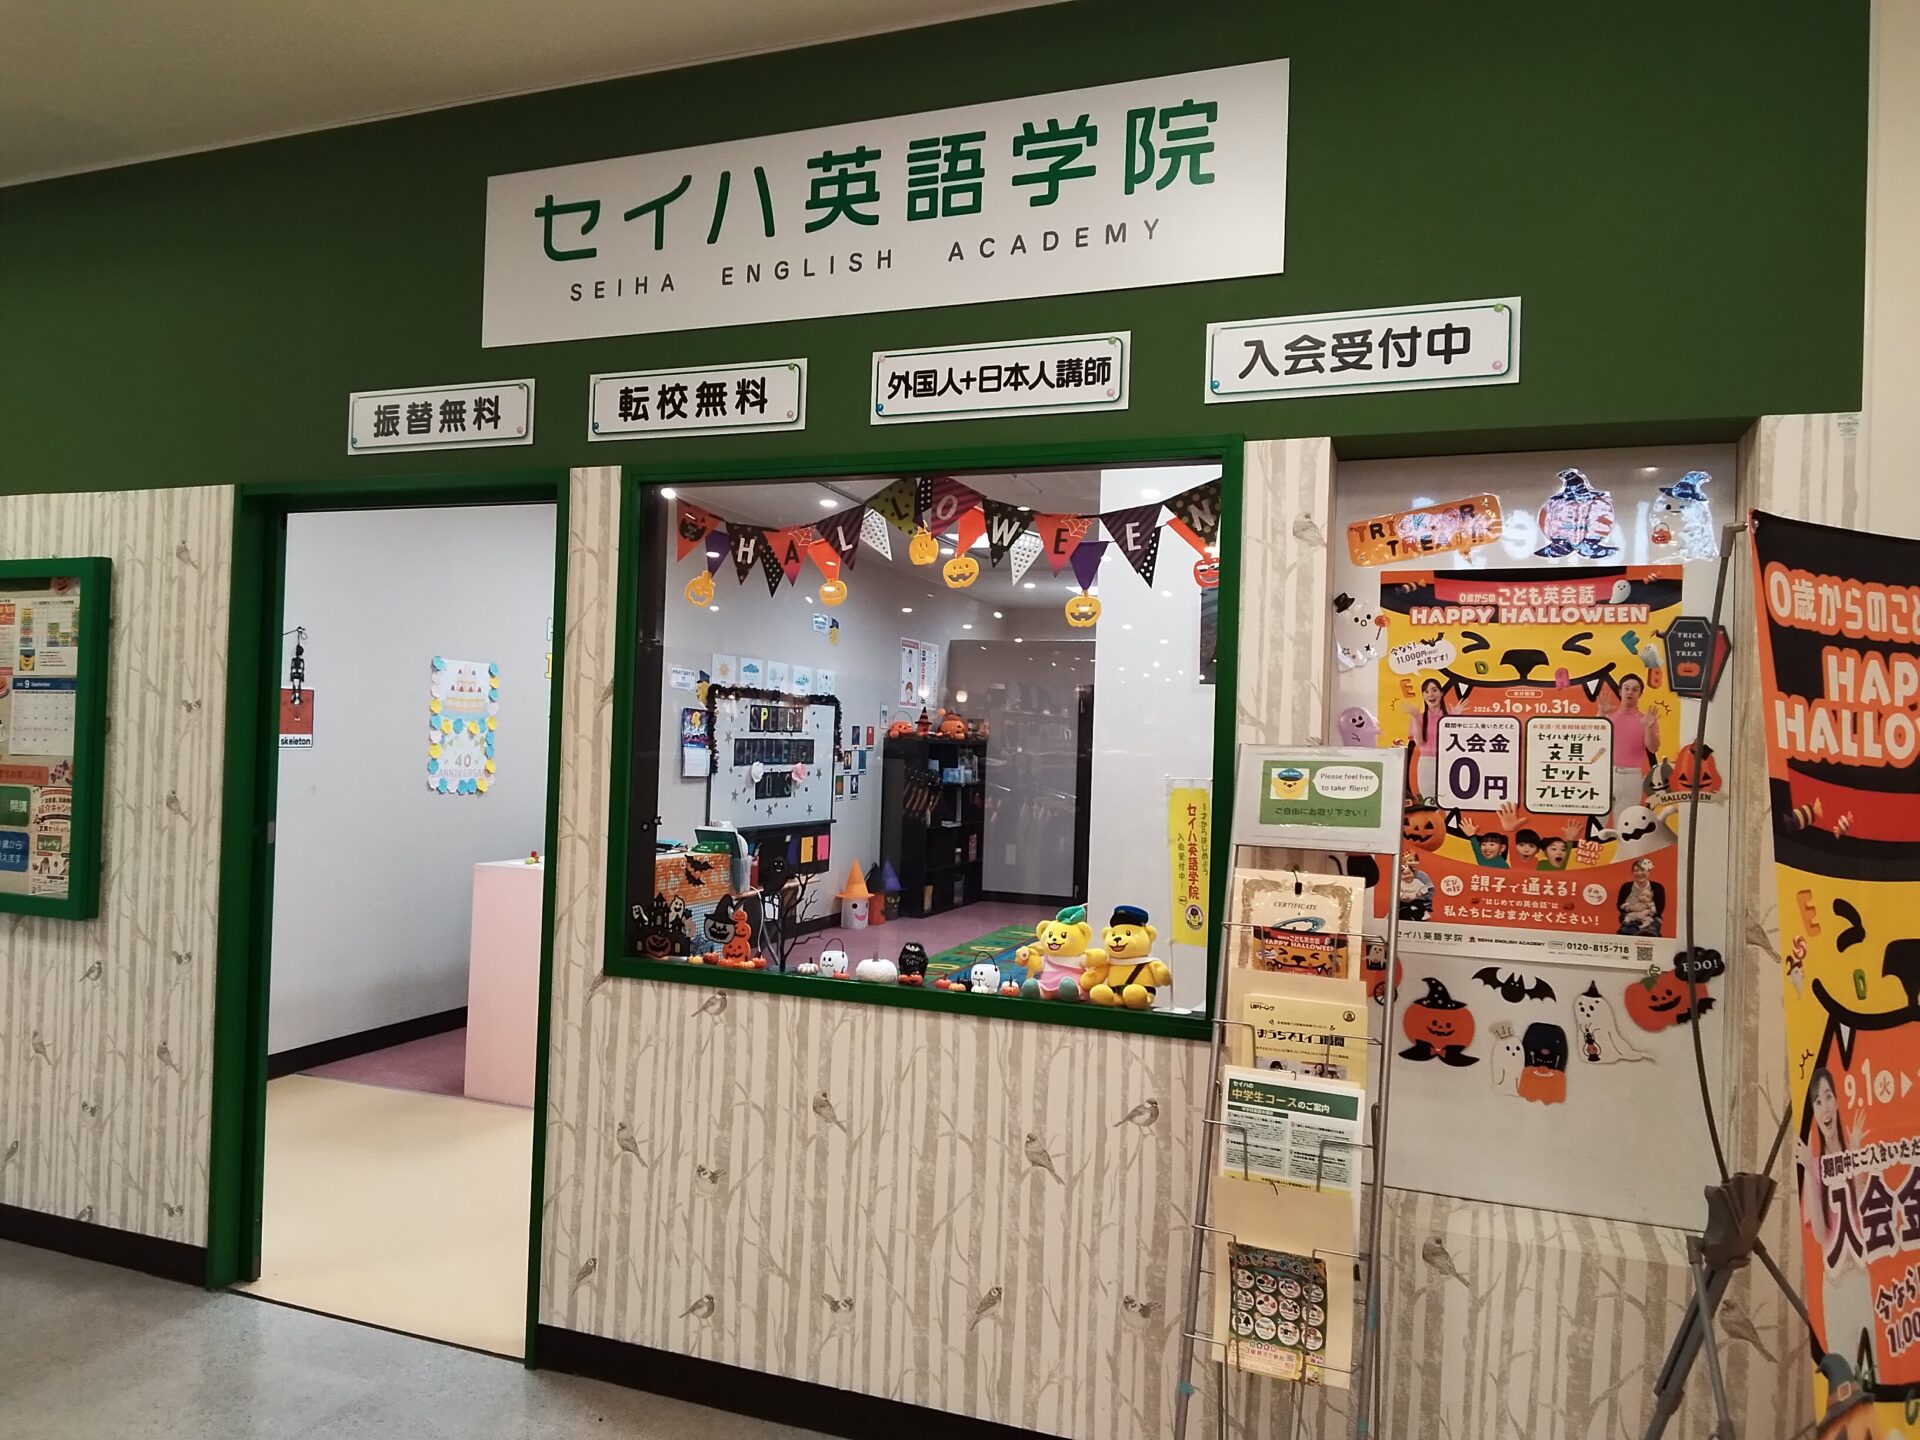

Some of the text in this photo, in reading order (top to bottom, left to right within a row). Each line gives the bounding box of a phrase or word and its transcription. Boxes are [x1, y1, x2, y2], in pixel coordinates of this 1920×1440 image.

[534, 98, 1218, 261] セイハ英語学院
[569, 219, 1161, 301] SEIHA ENGLISH ACADEMY
[1239, 324, 1472, 380] 入会受付中
[887, 356, 1112, 399] 外国人+日本人講師
[618, 376, 768, 422] 転校無料
[373, 395, 502, 438] 振替無料
[1498, 586, 1595, 606] こども英会話
[1411, 606, 1648, 625] HAPPY HALLOWEEN
[1537, 732, 1602, 741] セイハオリジナル
[1775, 698, 1920, 760] HALLO
[280, 736, 311, 746] skeleton
[1445, 733, 1510, 753] 入会金
[455, 754, 471, 768] 40
[1547, 743, 1584, 761] 文具
[1449, 757, 1508, 800] 0円
[1542, 764, 1590, 780] セット
[1536, 786, 1600, 800] プレゼント
[1187, 803, 1200, 900] セイハ英語学院
[1470, 875, 1577, 896] 親子で通える!
[1273, 901, 1318, 911] CERTIFICATE
[1443, 904, 1600, 926] 私たちにおまかせください!
[1566, 942, 1630, 954] 0120-815-718
[1231, 1088, 1330, 1114] 中学生コースのご案内
